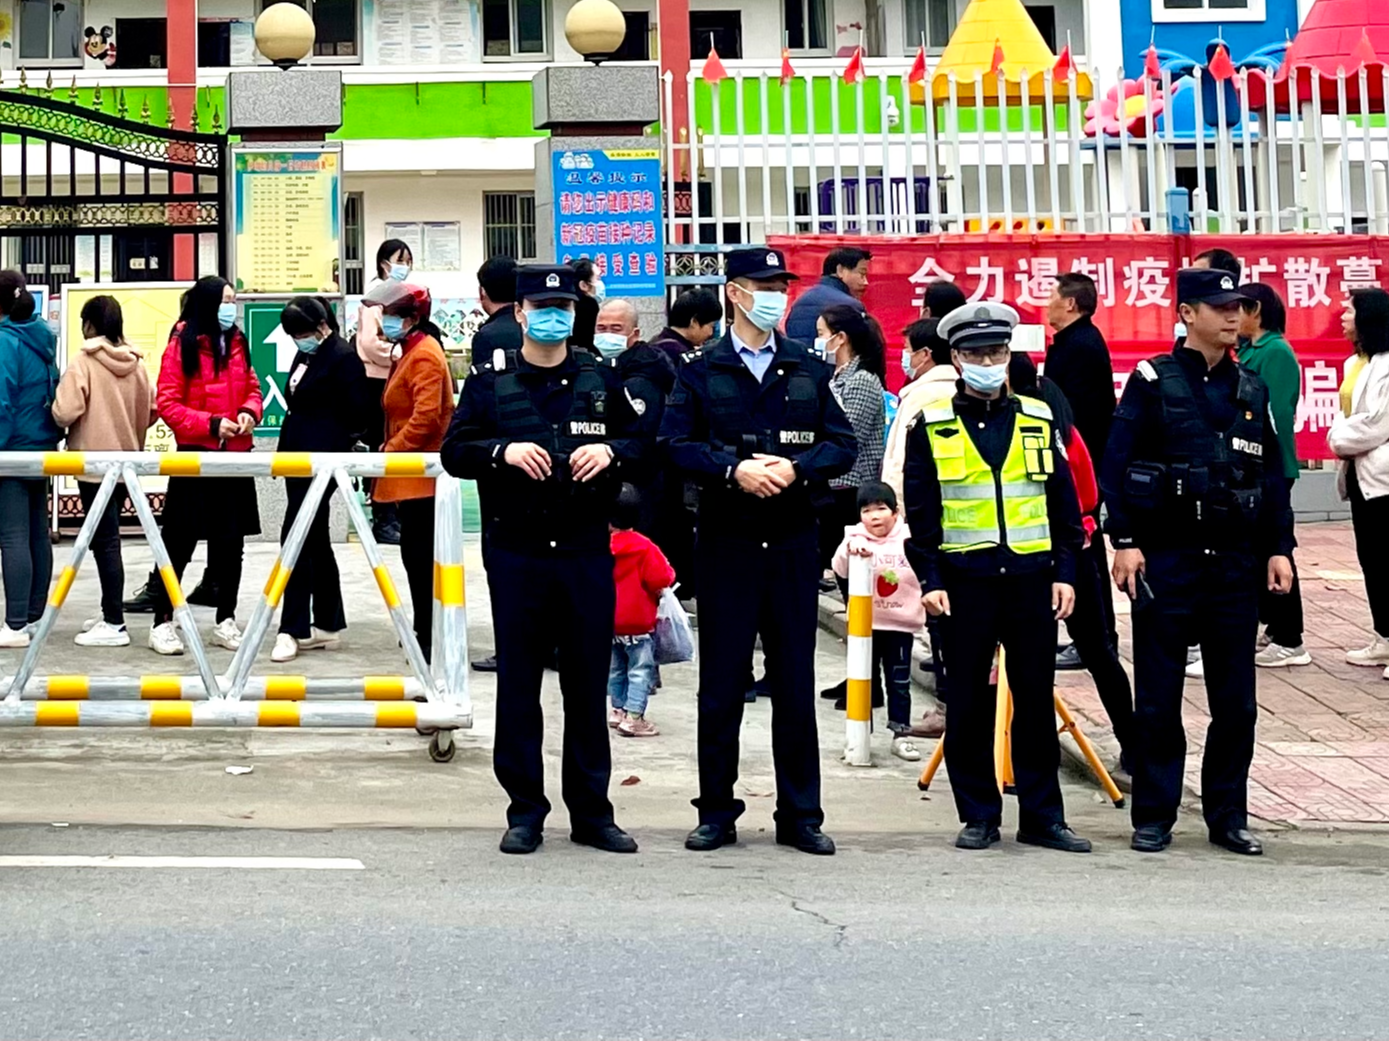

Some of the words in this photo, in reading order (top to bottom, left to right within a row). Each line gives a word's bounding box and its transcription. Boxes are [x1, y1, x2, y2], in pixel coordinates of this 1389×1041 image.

[566, 172, 647, 184] 温馨提示
[560, 191, 654, 214] 请您出示健康码和
[561, 221, 656, 245] 新冠疫苗接种记录
[563, 252, 657, 276] 接受查验
[908, 256, 1382, 308] 全力遏制疫扩散蔓
